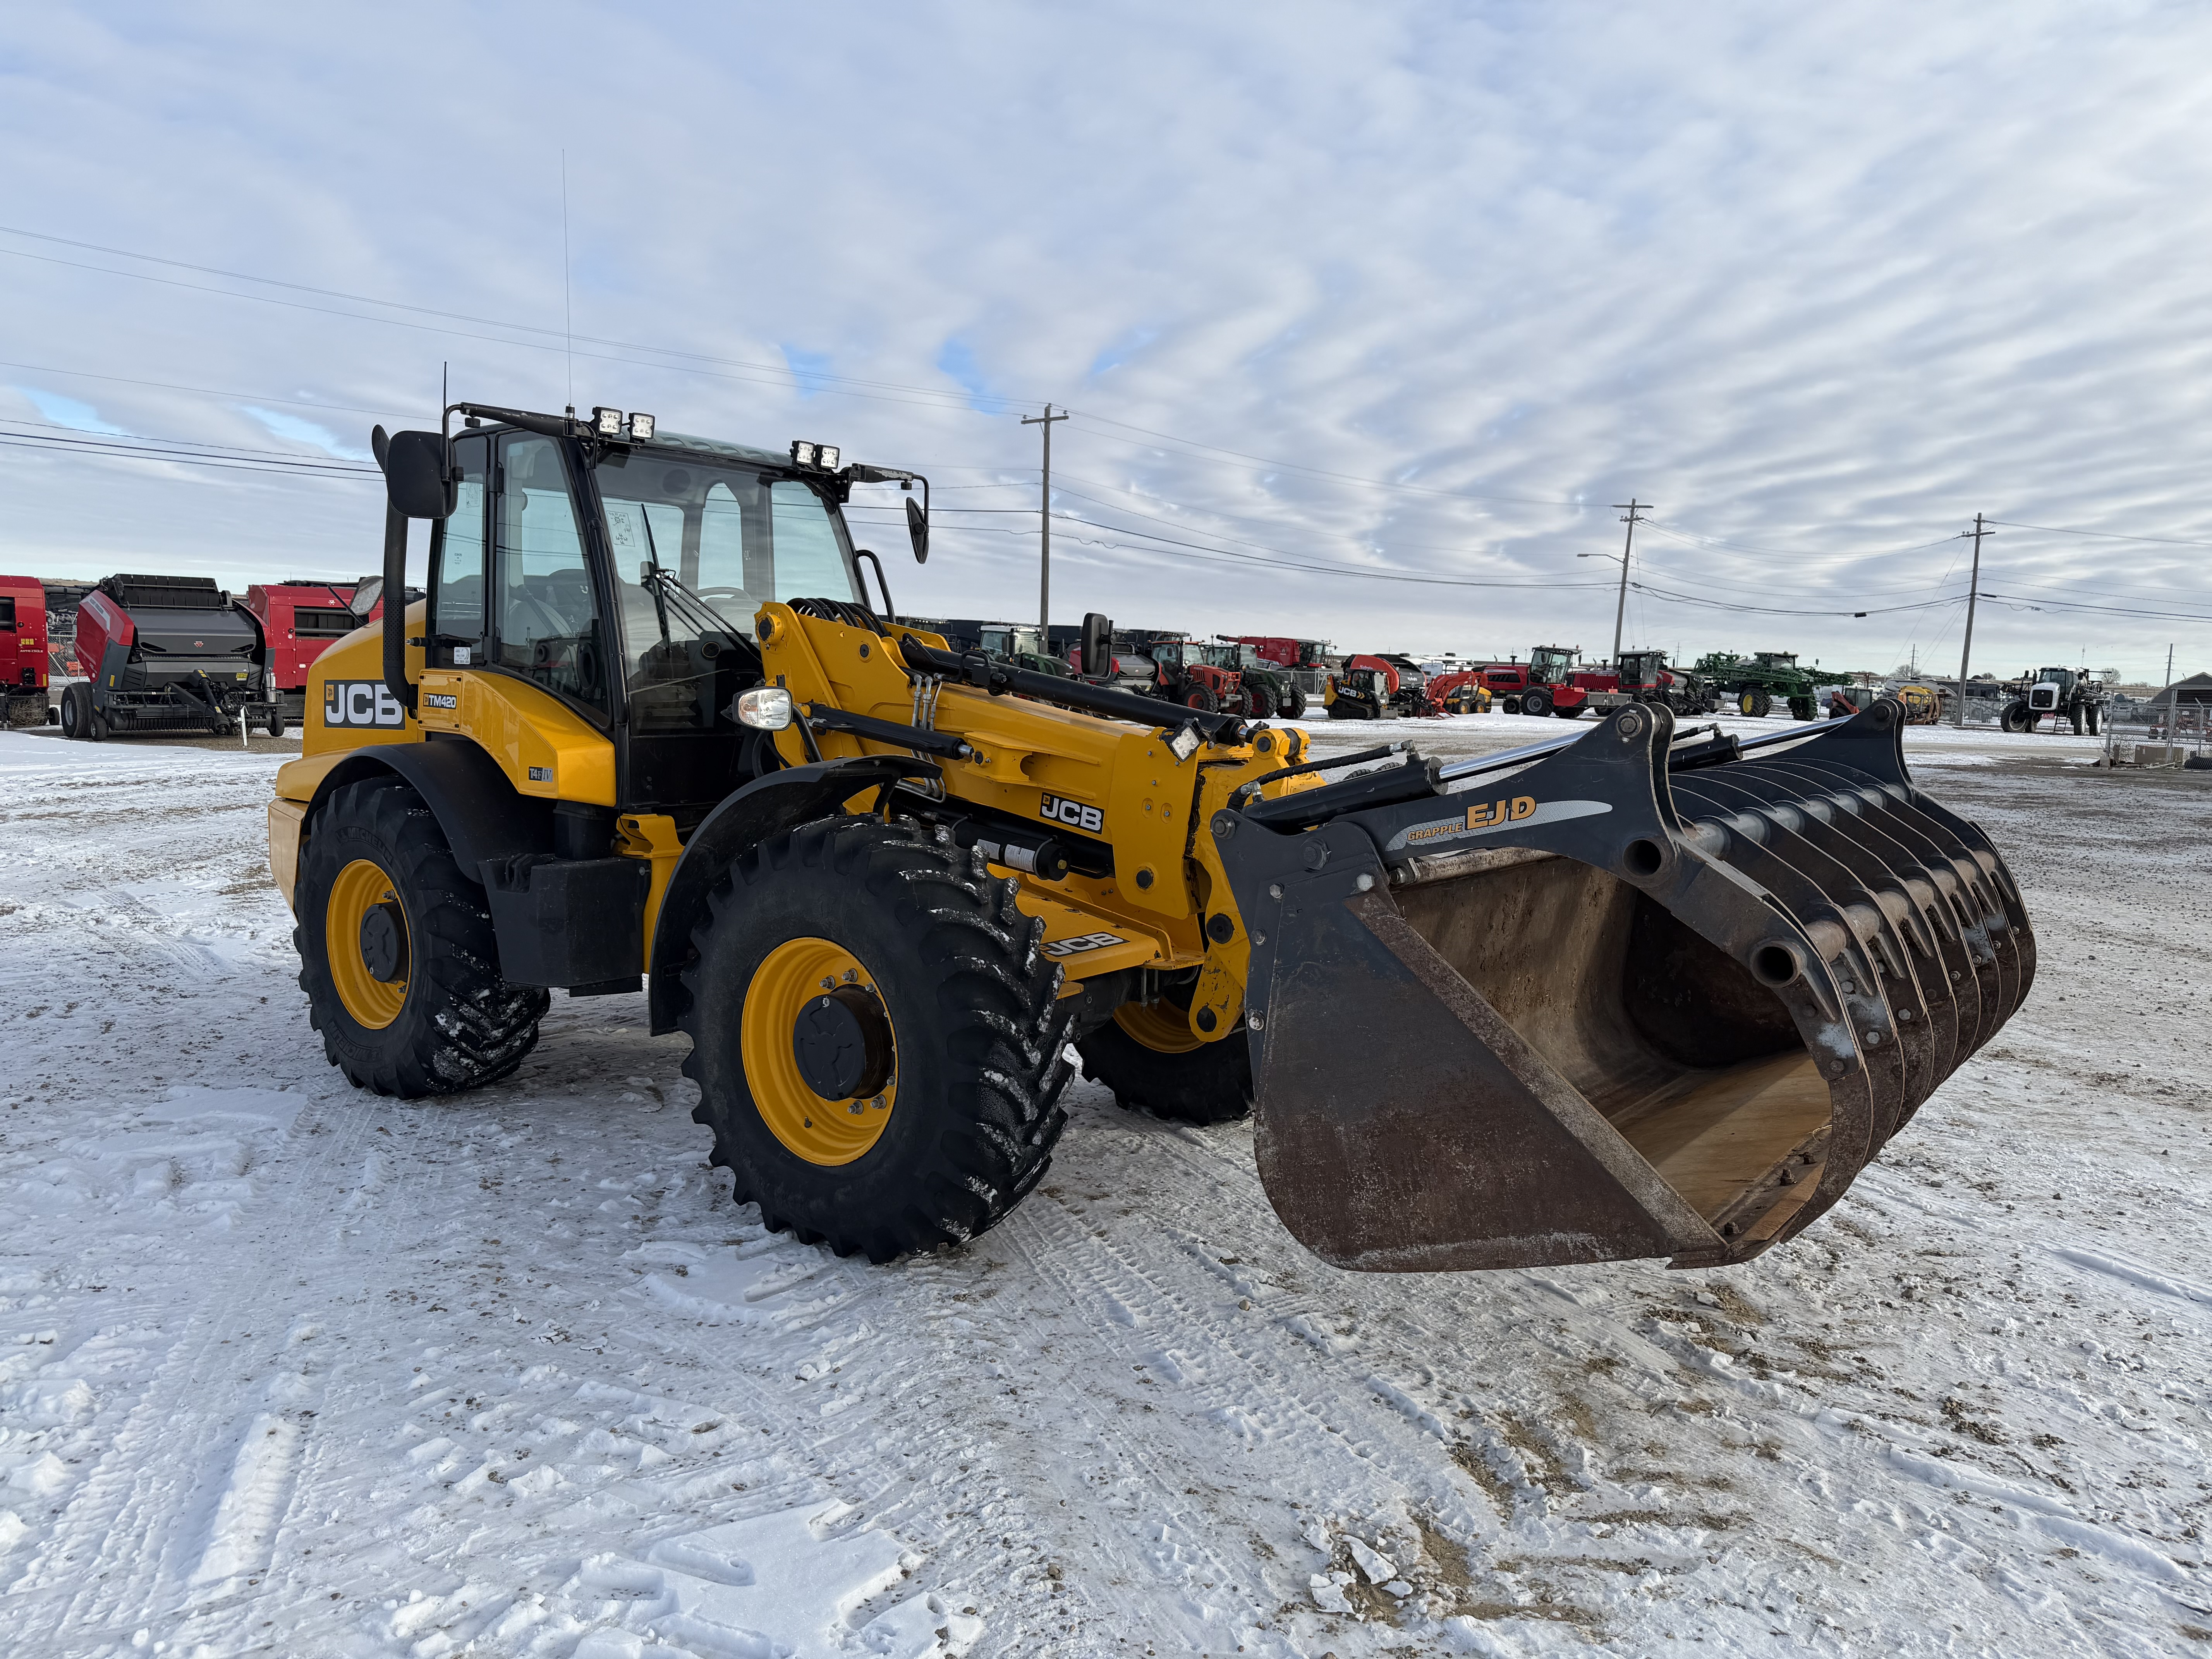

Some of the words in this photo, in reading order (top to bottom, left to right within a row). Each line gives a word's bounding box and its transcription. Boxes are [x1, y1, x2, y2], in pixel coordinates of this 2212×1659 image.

[326, 684, 402, 724] JCB
[429, 695, 456, 708] TM420
[1338, 687, 1357, 697] JCB
[1042, 797, 1102, 831] JCB
[1407, 822, 1463, 841] GRAPPLE
[1467, 795, 1537, 830] EJD
[347, 827, 393, 863] MICHELIN
[1047, 933, 1123, 955] JCB
[327, 1021, 370, 1061] MICHELIN
